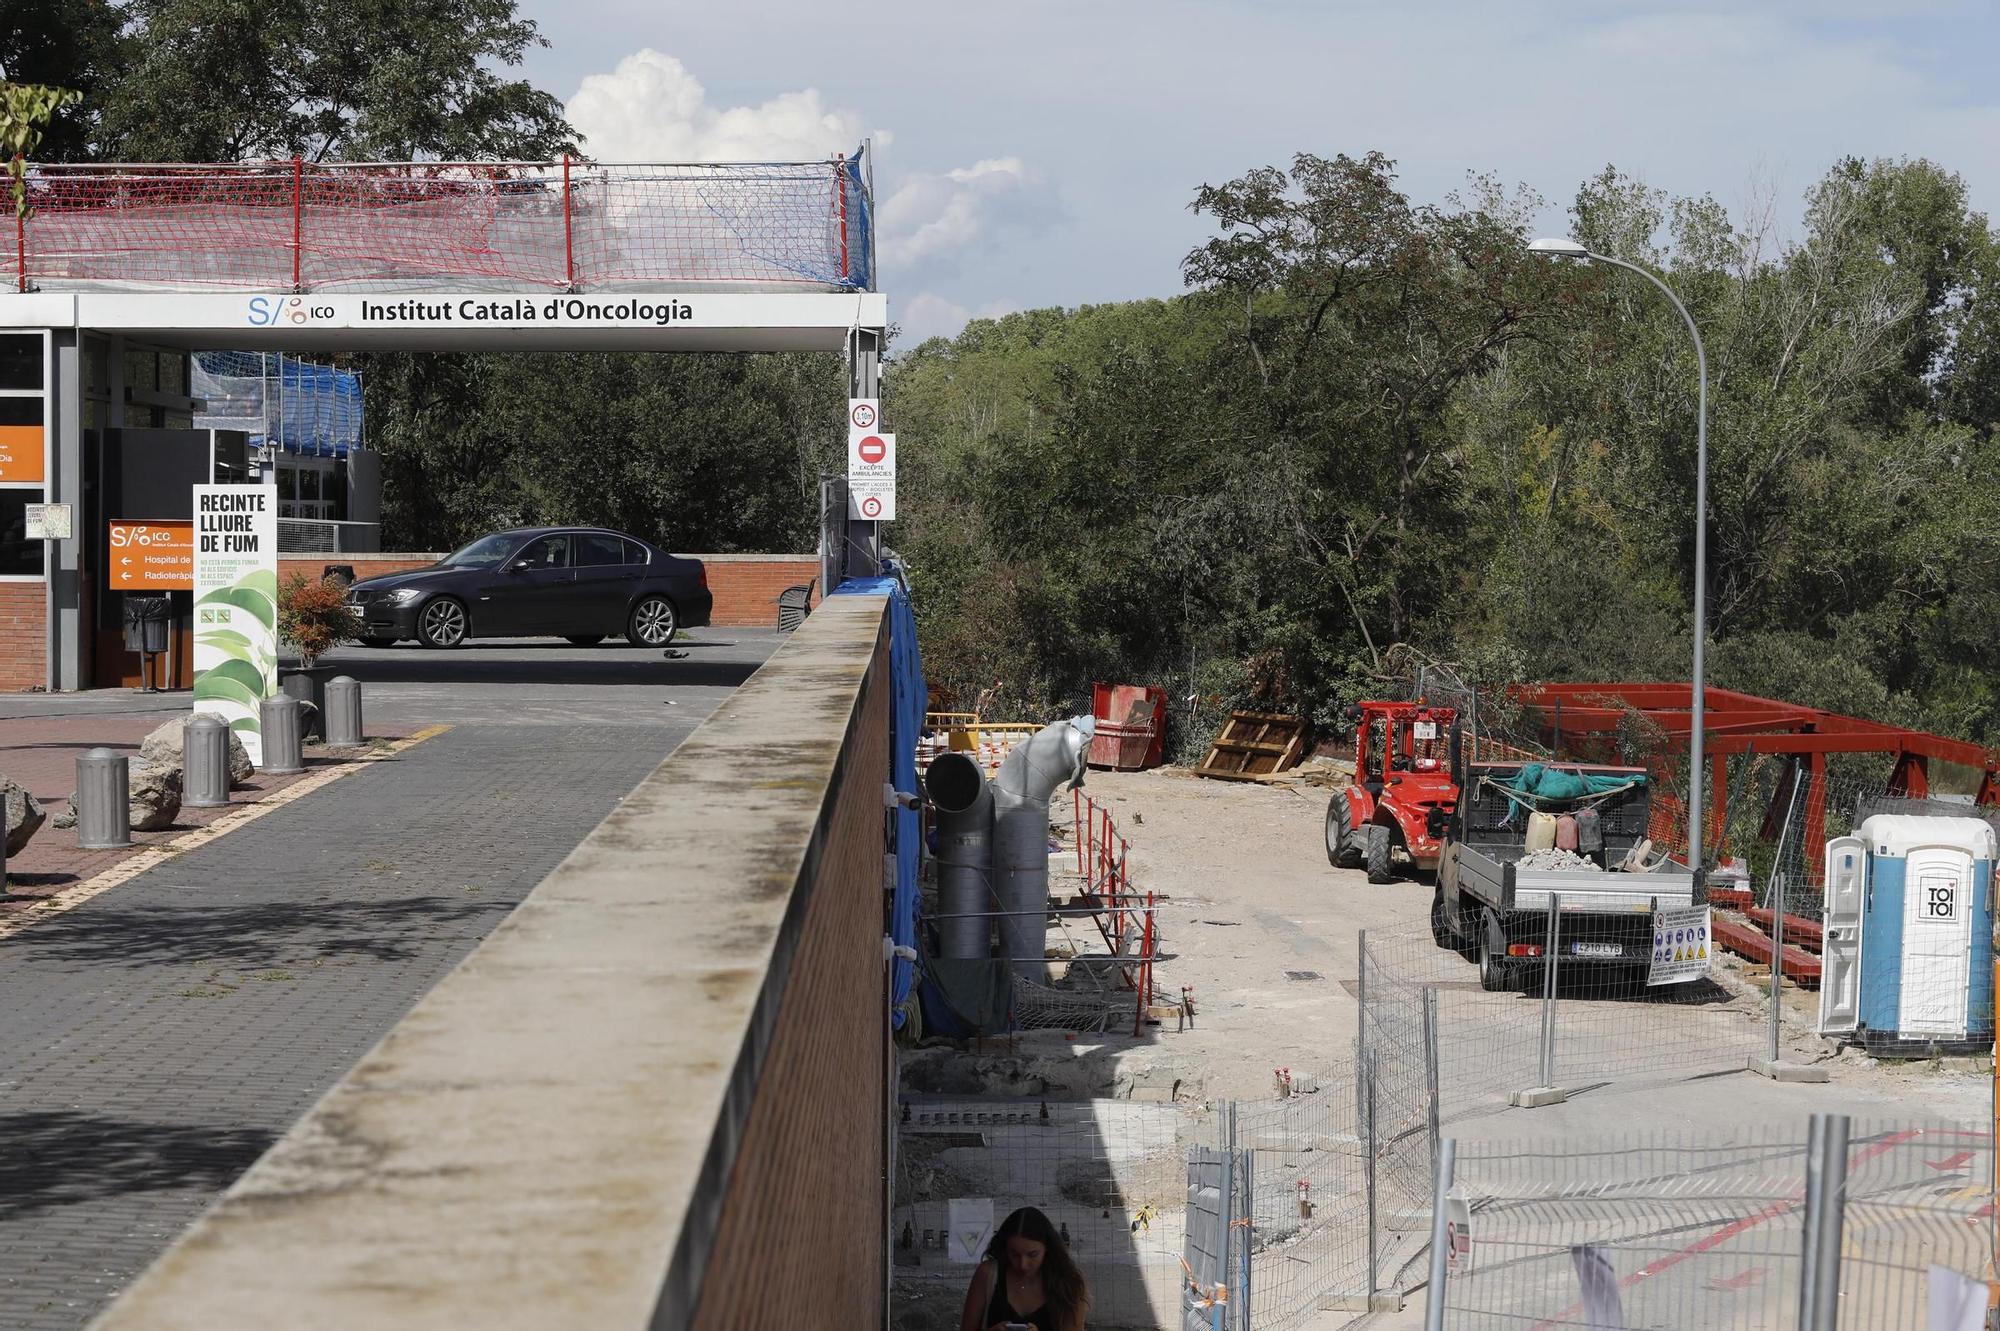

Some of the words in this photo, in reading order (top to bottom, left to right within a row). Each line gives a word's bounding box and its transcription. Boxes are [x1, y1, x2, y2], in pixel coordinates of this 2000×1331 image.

[310, 307, 335, 319] ICO
[362, 300, 452, 320] Institut
[459, 299, 536, 320] Català
[543, 299, 693, 325] d'Oncologia
[200, 494, 266, 512] RECINTE
[200, 515, 253, 532] LLIURE
[152, 532, 171, 541] ICO
[201, 535, 219, 552] DE
[224, 535, 258, 552] FUM
[144, 556, 178, 564] Hospital
[144, 572, 193, 581] Radioteràpi
